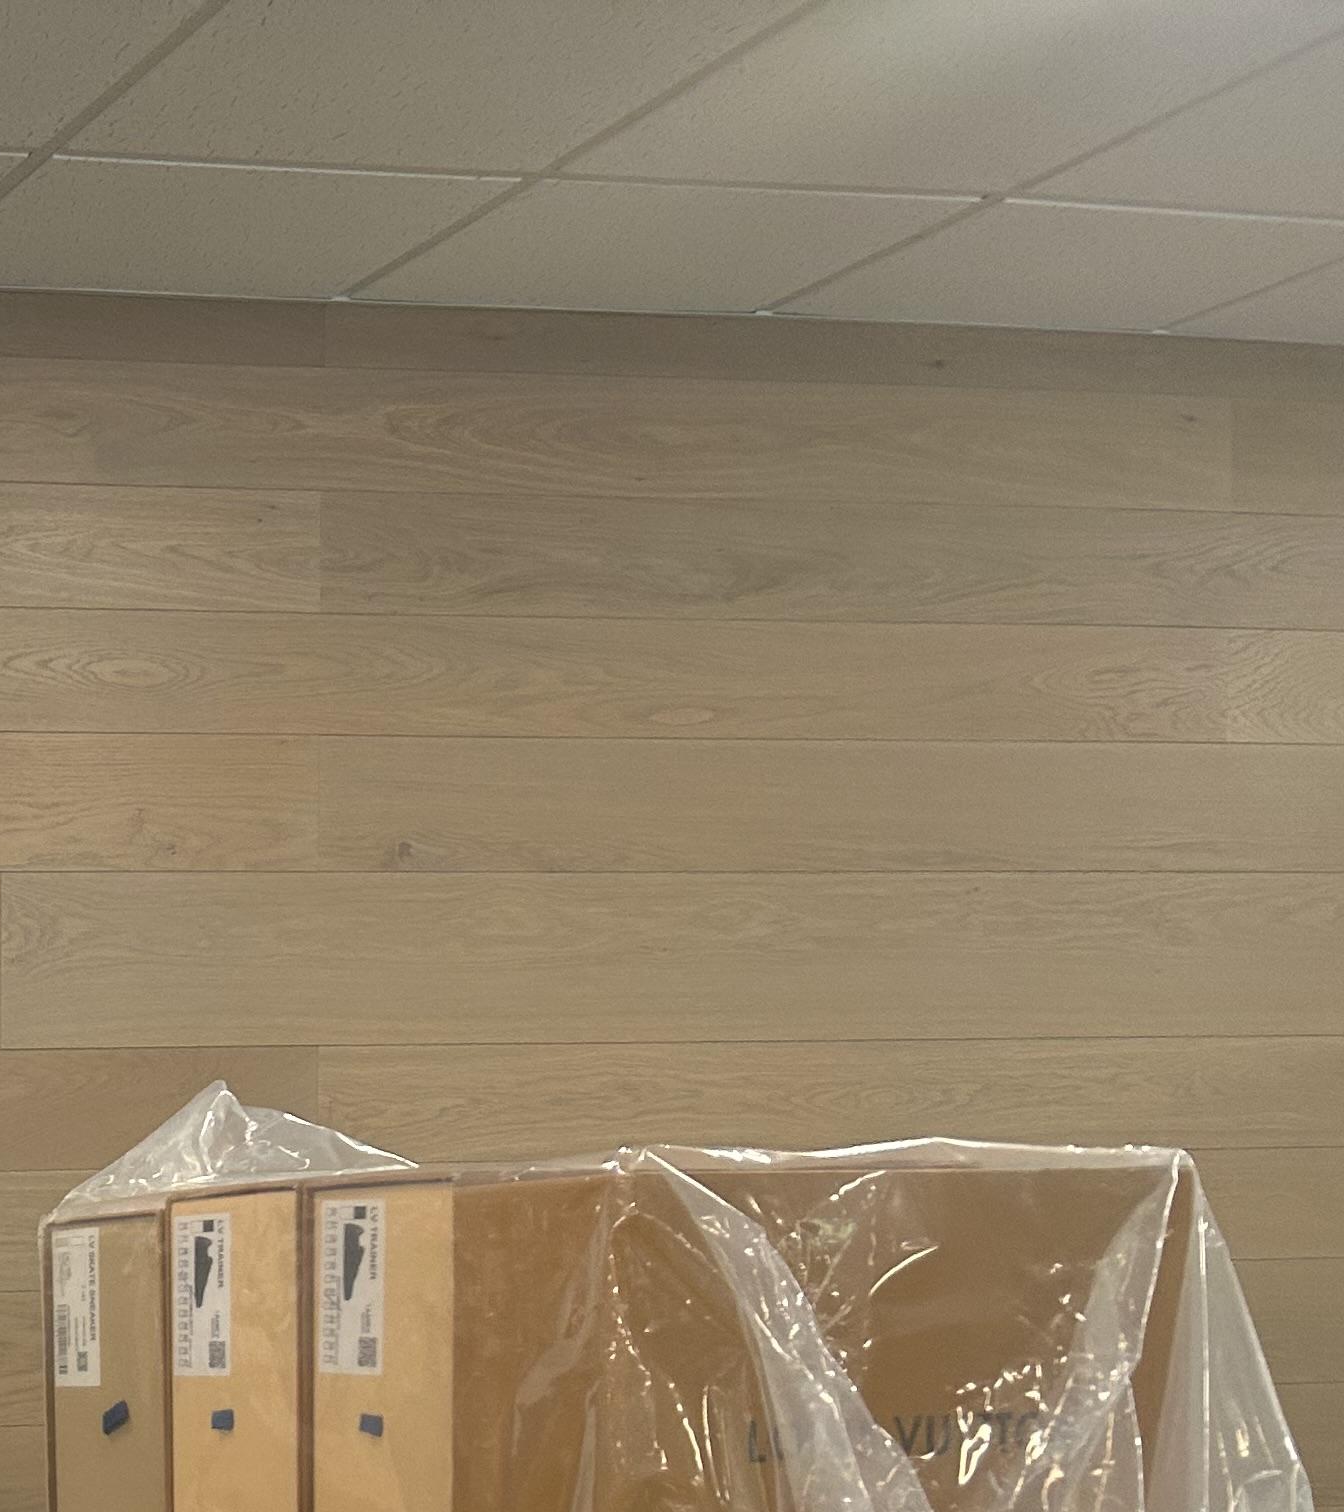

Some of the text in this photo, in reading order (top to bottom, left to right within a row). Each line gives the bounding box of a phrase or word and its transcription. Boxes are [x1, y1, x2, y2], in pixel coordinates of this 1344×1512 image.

[216, 1237, 225, 1289] TRAINER
[369, 1206, 379, 1281] LV TRAINER
[88, 1289, 97, 1342] SNEAKER
